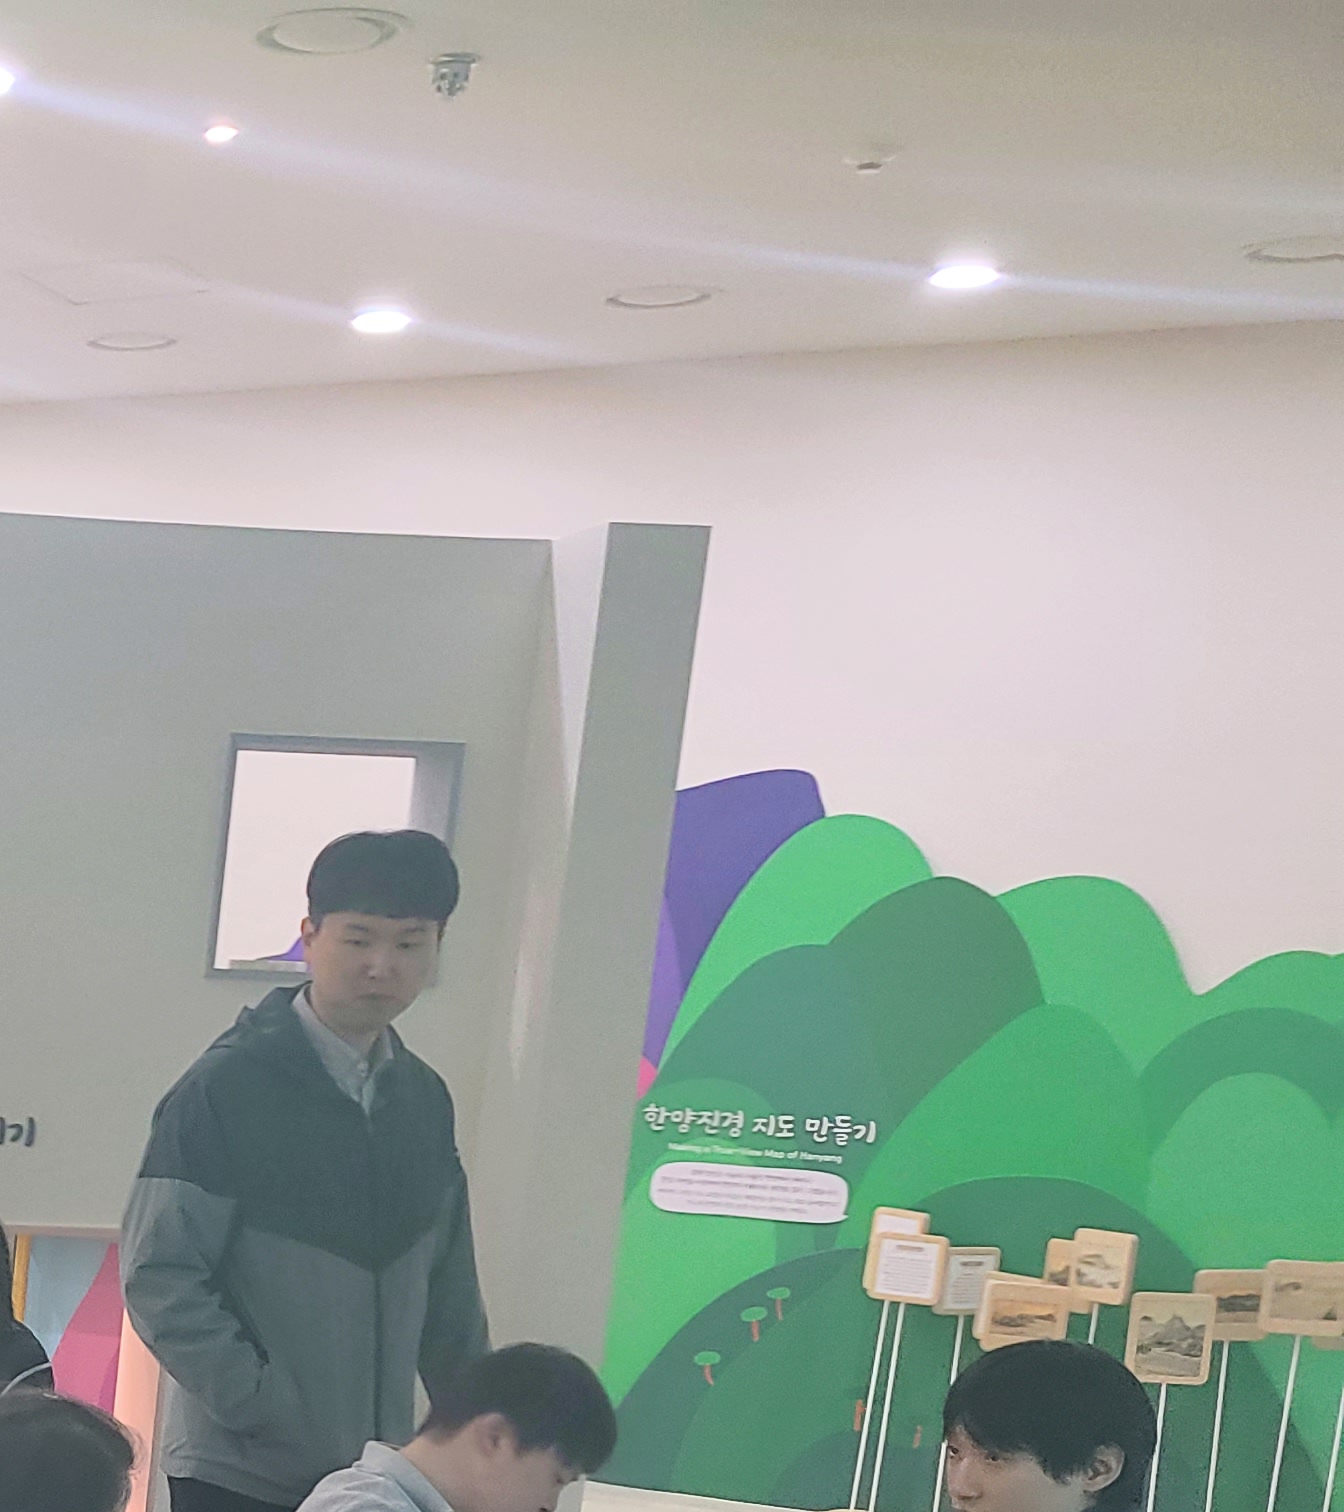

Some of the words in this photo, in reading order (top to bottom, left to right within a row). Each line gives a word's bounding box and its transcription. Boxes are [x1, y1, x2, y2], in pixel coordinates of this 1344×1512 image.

[642, 1103, 745, 1138] 한양진경
[751, 1114, 796, 1138] 지도
[804, 1114, 878, 1147] 만들기
